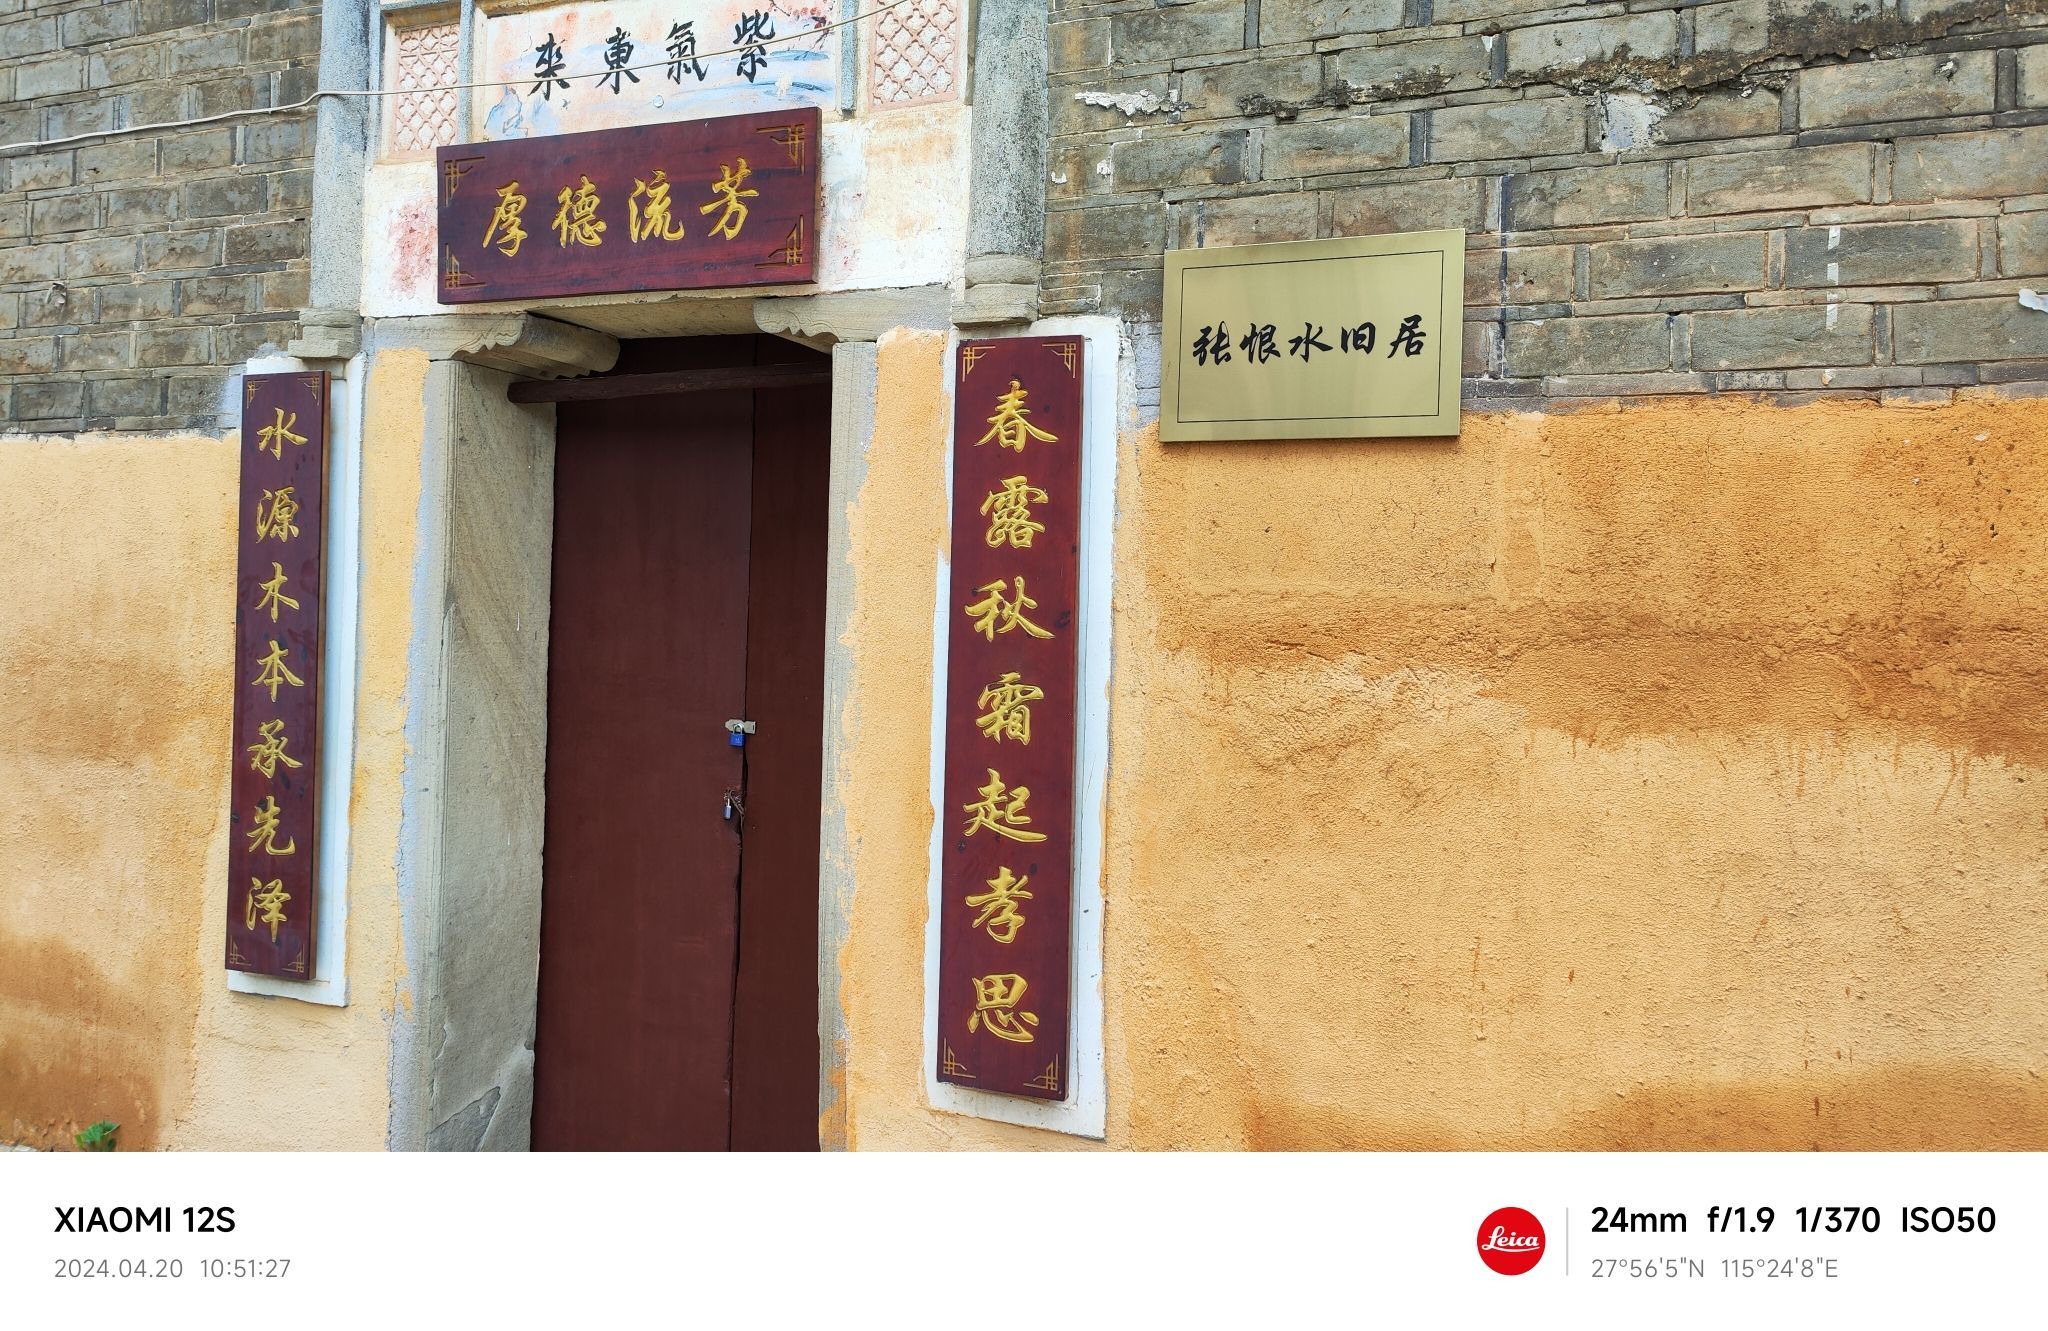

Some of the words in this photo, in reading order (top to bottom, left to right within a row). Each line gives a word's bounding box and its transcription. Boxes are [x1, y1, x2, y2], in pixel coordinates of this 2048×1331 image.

[482, 156, 760, 258] 厚德流芳
[1192, 314, 1427, 366] 张恨水旧居
[246, 407, 309, 943] 水源木本承先泽
[963, 380, 1058, 1043] 春露秋霜起孝思
